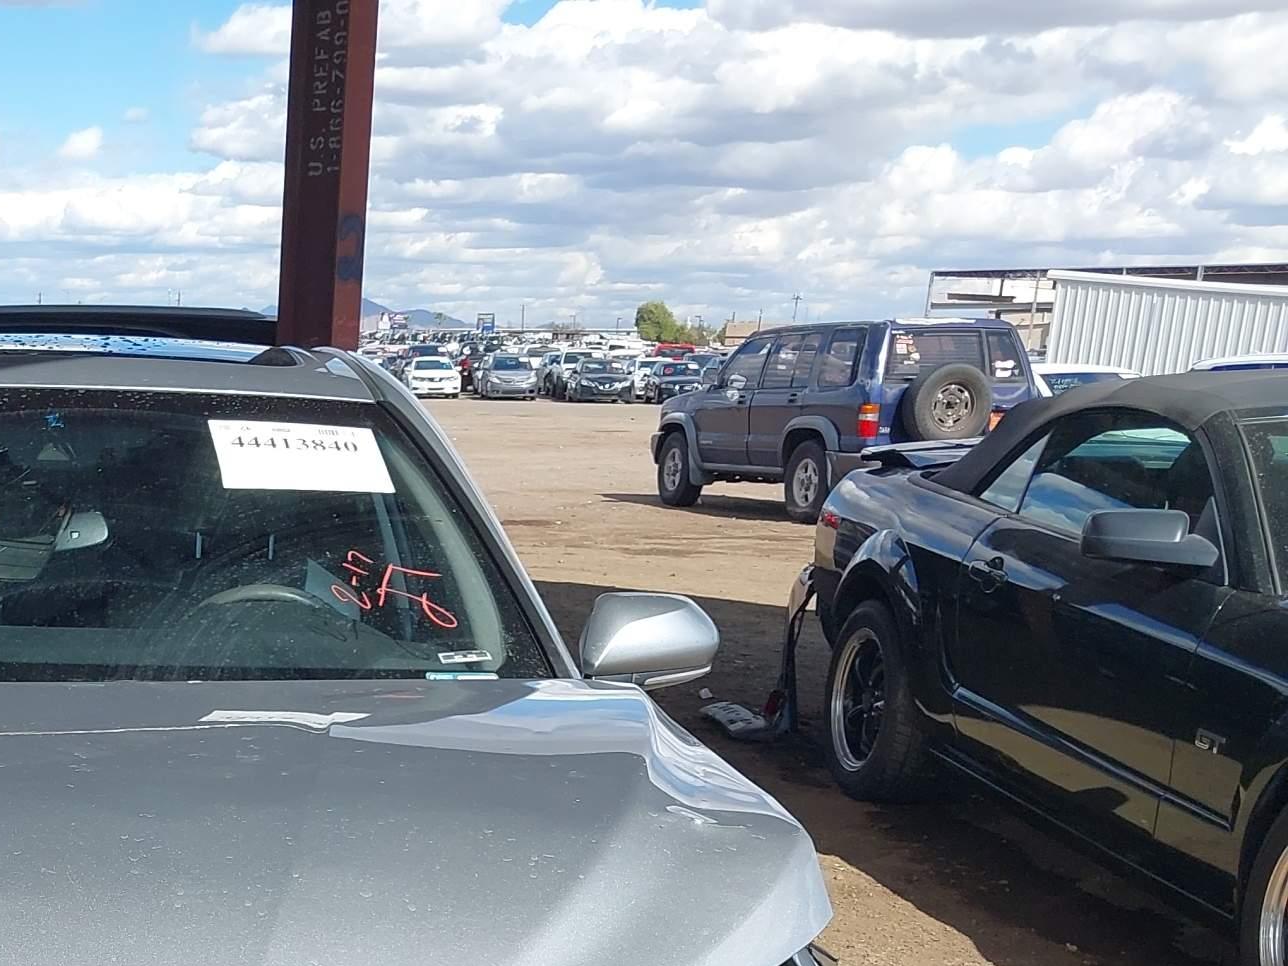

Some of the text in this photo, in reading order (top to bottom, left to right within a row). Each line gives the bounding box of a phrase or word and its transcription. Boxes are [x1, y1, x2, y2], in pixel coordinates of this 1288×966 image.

[312, 9, 333, 112] PREFAB
[231, 435, 359, 452] 44413840
[1195, 728, 1226, 754] GT
